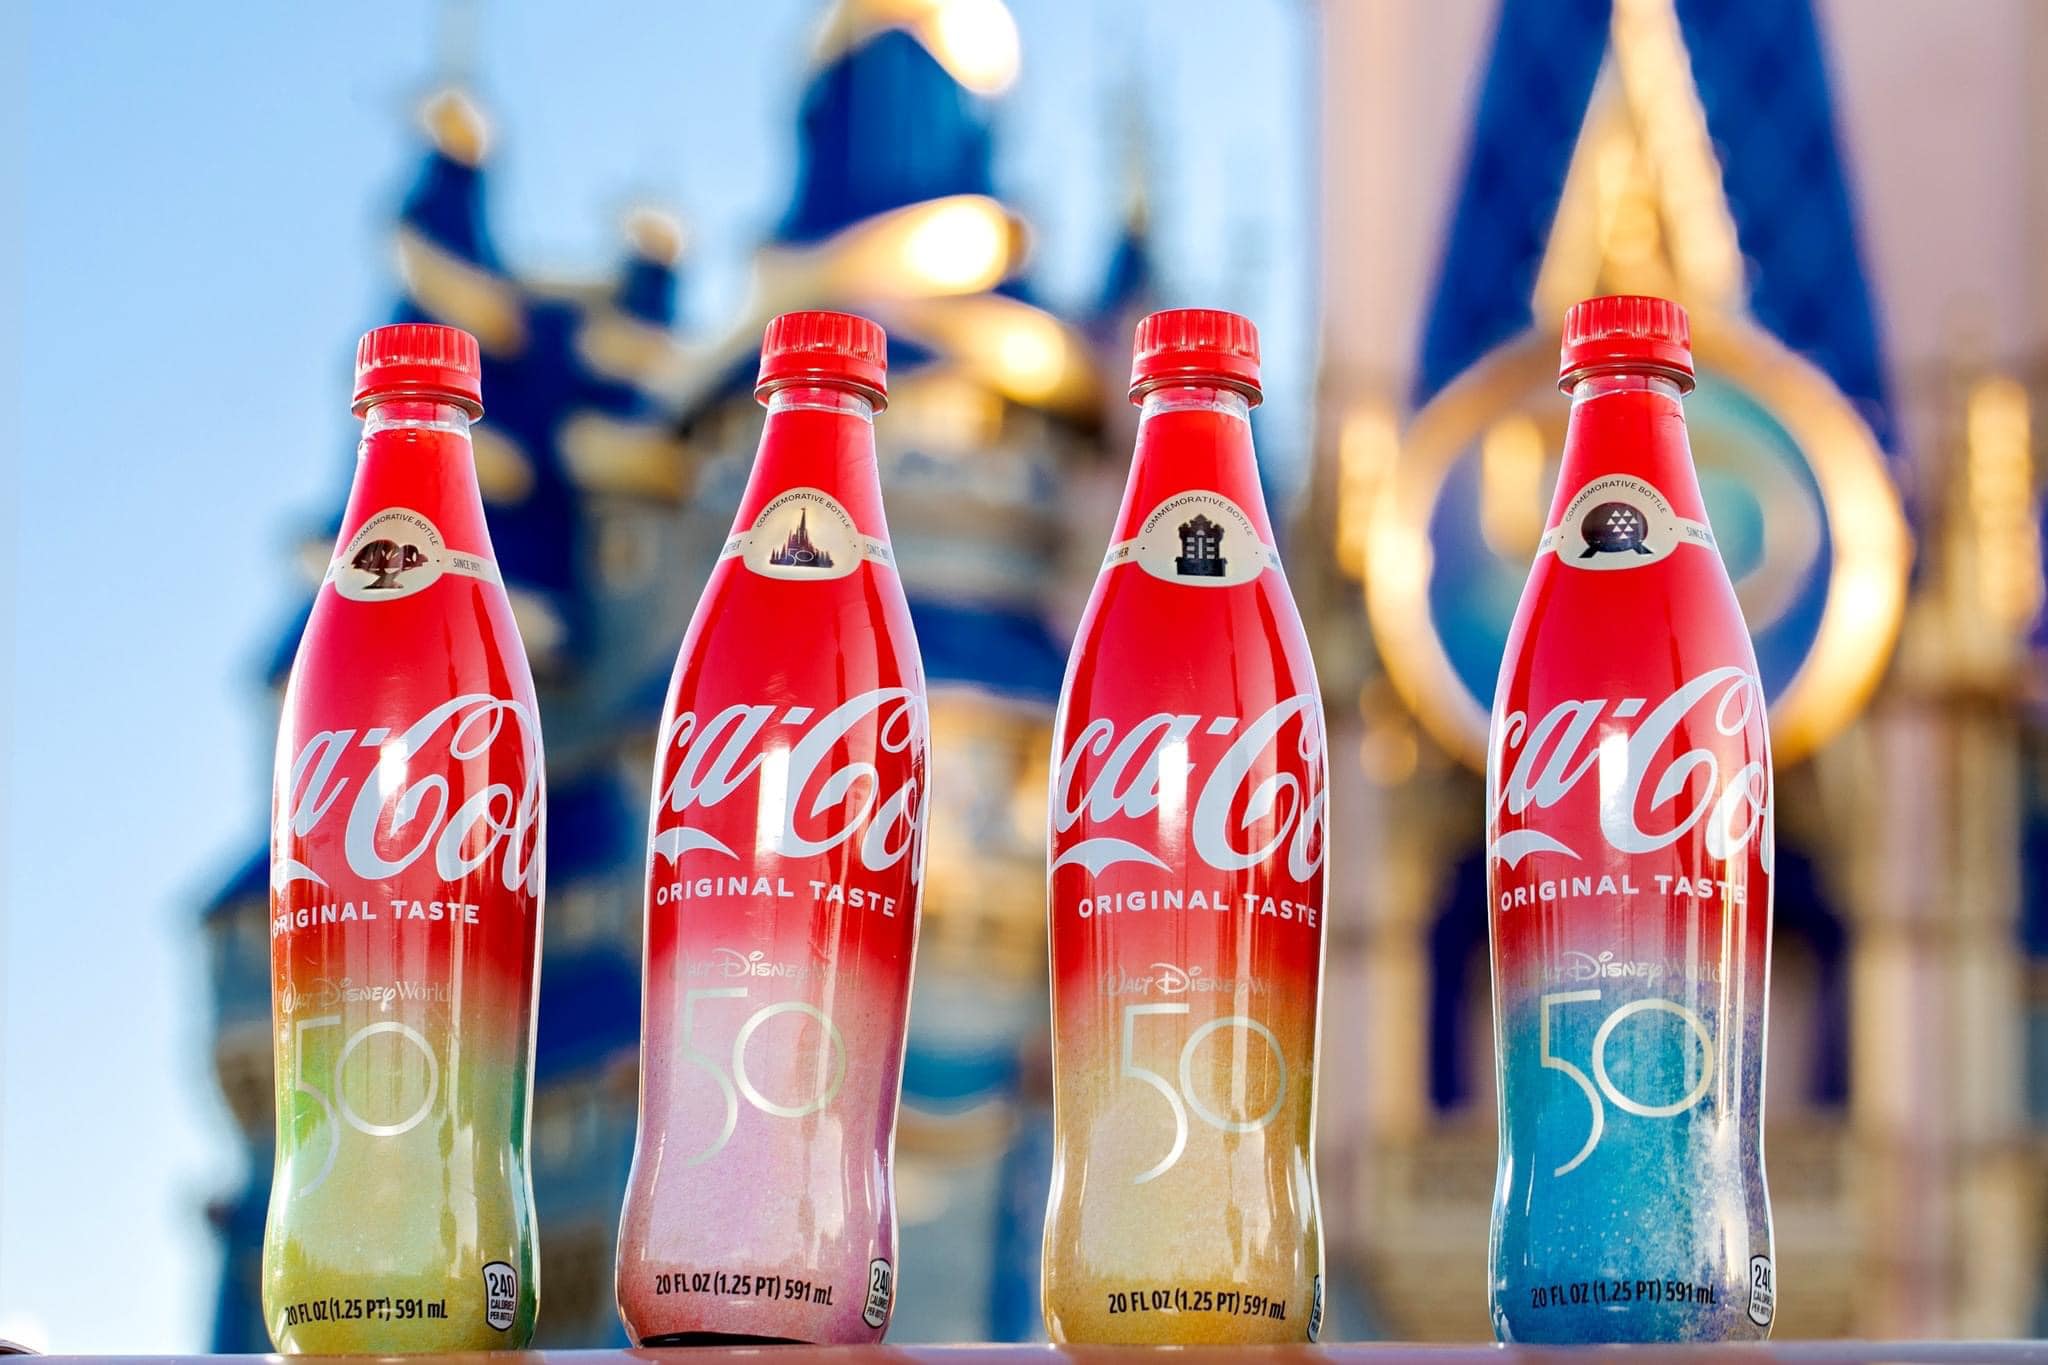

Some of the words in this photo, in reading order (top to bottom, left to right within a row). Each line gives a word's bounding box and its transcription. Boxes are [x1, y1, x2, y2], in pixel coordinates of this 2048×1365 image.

[756, 493, 825, 529] COMMEMORATIVE
[826, 501, 850, 529] BOTTLE
[1145, 496, 1225, 534] COMMEMORATIVE
[1226, 505, 1253, 536] BOTTLE
[1566, 480, 1637, 522] COMMEMORATIVE
[1638, 486, 1668, 514] BOTTLE
[350, 513, 415, 551] COMMEMORATIVE
[414, 519, 440, 546] BOTTLE
[452, 557, 471, 570] SINCE
[656, 877, 794, 905] ORIGINAL
[809, 880, 896, 917] TASTE
[1078, 889, 1230, 918] ORIGINAL
[1243, 893, 1317, 928] TASTE
[1500, 875, 1639, 911] ORIGINAL
[1654, 875, 1746, 904] TASTE
[272, 901, 377, 938] ORIGINAL
[391, 900, 480, 924] TASTE
[395, 981, 450, 1002] World
[682, 987, 847, 1168] 50
[1121, 1003, 1287, 1184] 50
[1541, 989, 1713, 1177] 50
[295, 1015, 439, 1197] 50
[489, 1272, 514, 1298] 240
[656, 1274, 672, 1295] 20
[674, 1274, 690, 1293] FL
[692, 1273, 710, 1292] OZ
[714, 1271, 751, 1296] (1.25
[755, 1275, 781, 1300] PT)
[784, 1279, 811, 1300] 591
[813, 1285, 833, 1306] mL
[1531, 1288, 1547, 1309] 20
[1551, 1285, 1567, 1306] FL
[1571, 1282, 1588, 1304] OZ
[1593, 1280, 1631, 1304] (1.25
[1636, 1279, 1661, 1304] PT)
[1665, 1281, 1693, 1301] 591
[1696, 1284, 1716, 1304] mL
[285, 1307, 298, 1326] 20
[298, 1304, 312, 1323] FL
[314, 1300, 328, 1320] OZ
[330, 1296, 362, 1322] (1.25
[366, 1297, 391, 1321] PT)
[395, 1299, 423, 1319] 591
[427, 1299, 448, 1319] mL
[1108, 1293, 1127, 1314] 20
[1131, 1292, 1149, 1312] FL
[1152, 1290, 1171, 1310] OZ
[1175, 1288, 1212, 1312] (1.25
[1216, 1291, 1240, 1316] PT)
[1243, 1294, 1268, 1318] 591
[1268, 1300, 1286, 1321] mL
